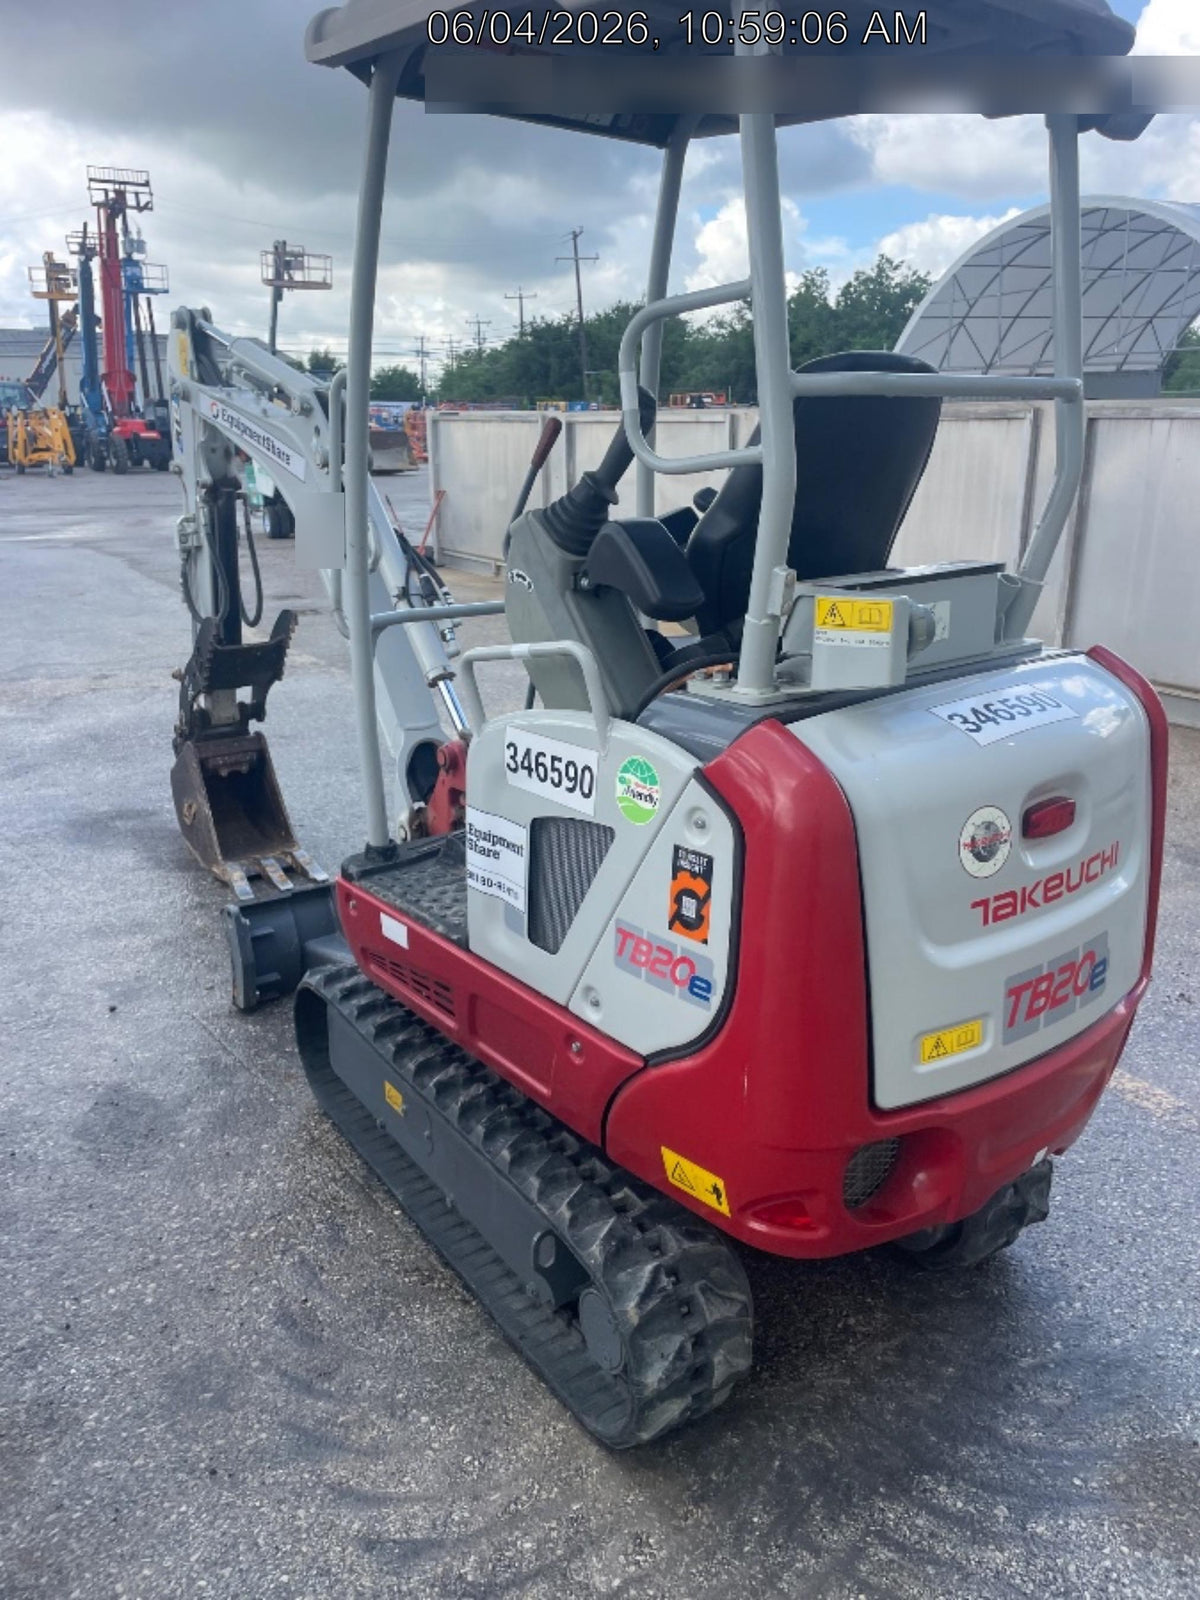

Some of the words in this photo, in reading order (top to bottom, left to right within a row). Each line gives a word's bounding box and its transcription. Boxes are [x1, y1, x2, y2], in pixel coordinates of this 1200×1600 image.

[947, 691, 1062, 733] 346590
[505, 742, 595, 800] 346590
[467, 822, 524, 858] Equipment
[467, 838, 501, 860] Share
[969, 841, 1120, 927] TAKEUCHI
[616, 926, 713, 1003] TB20e
[1006, 949, 1108, 1029] TB20e
